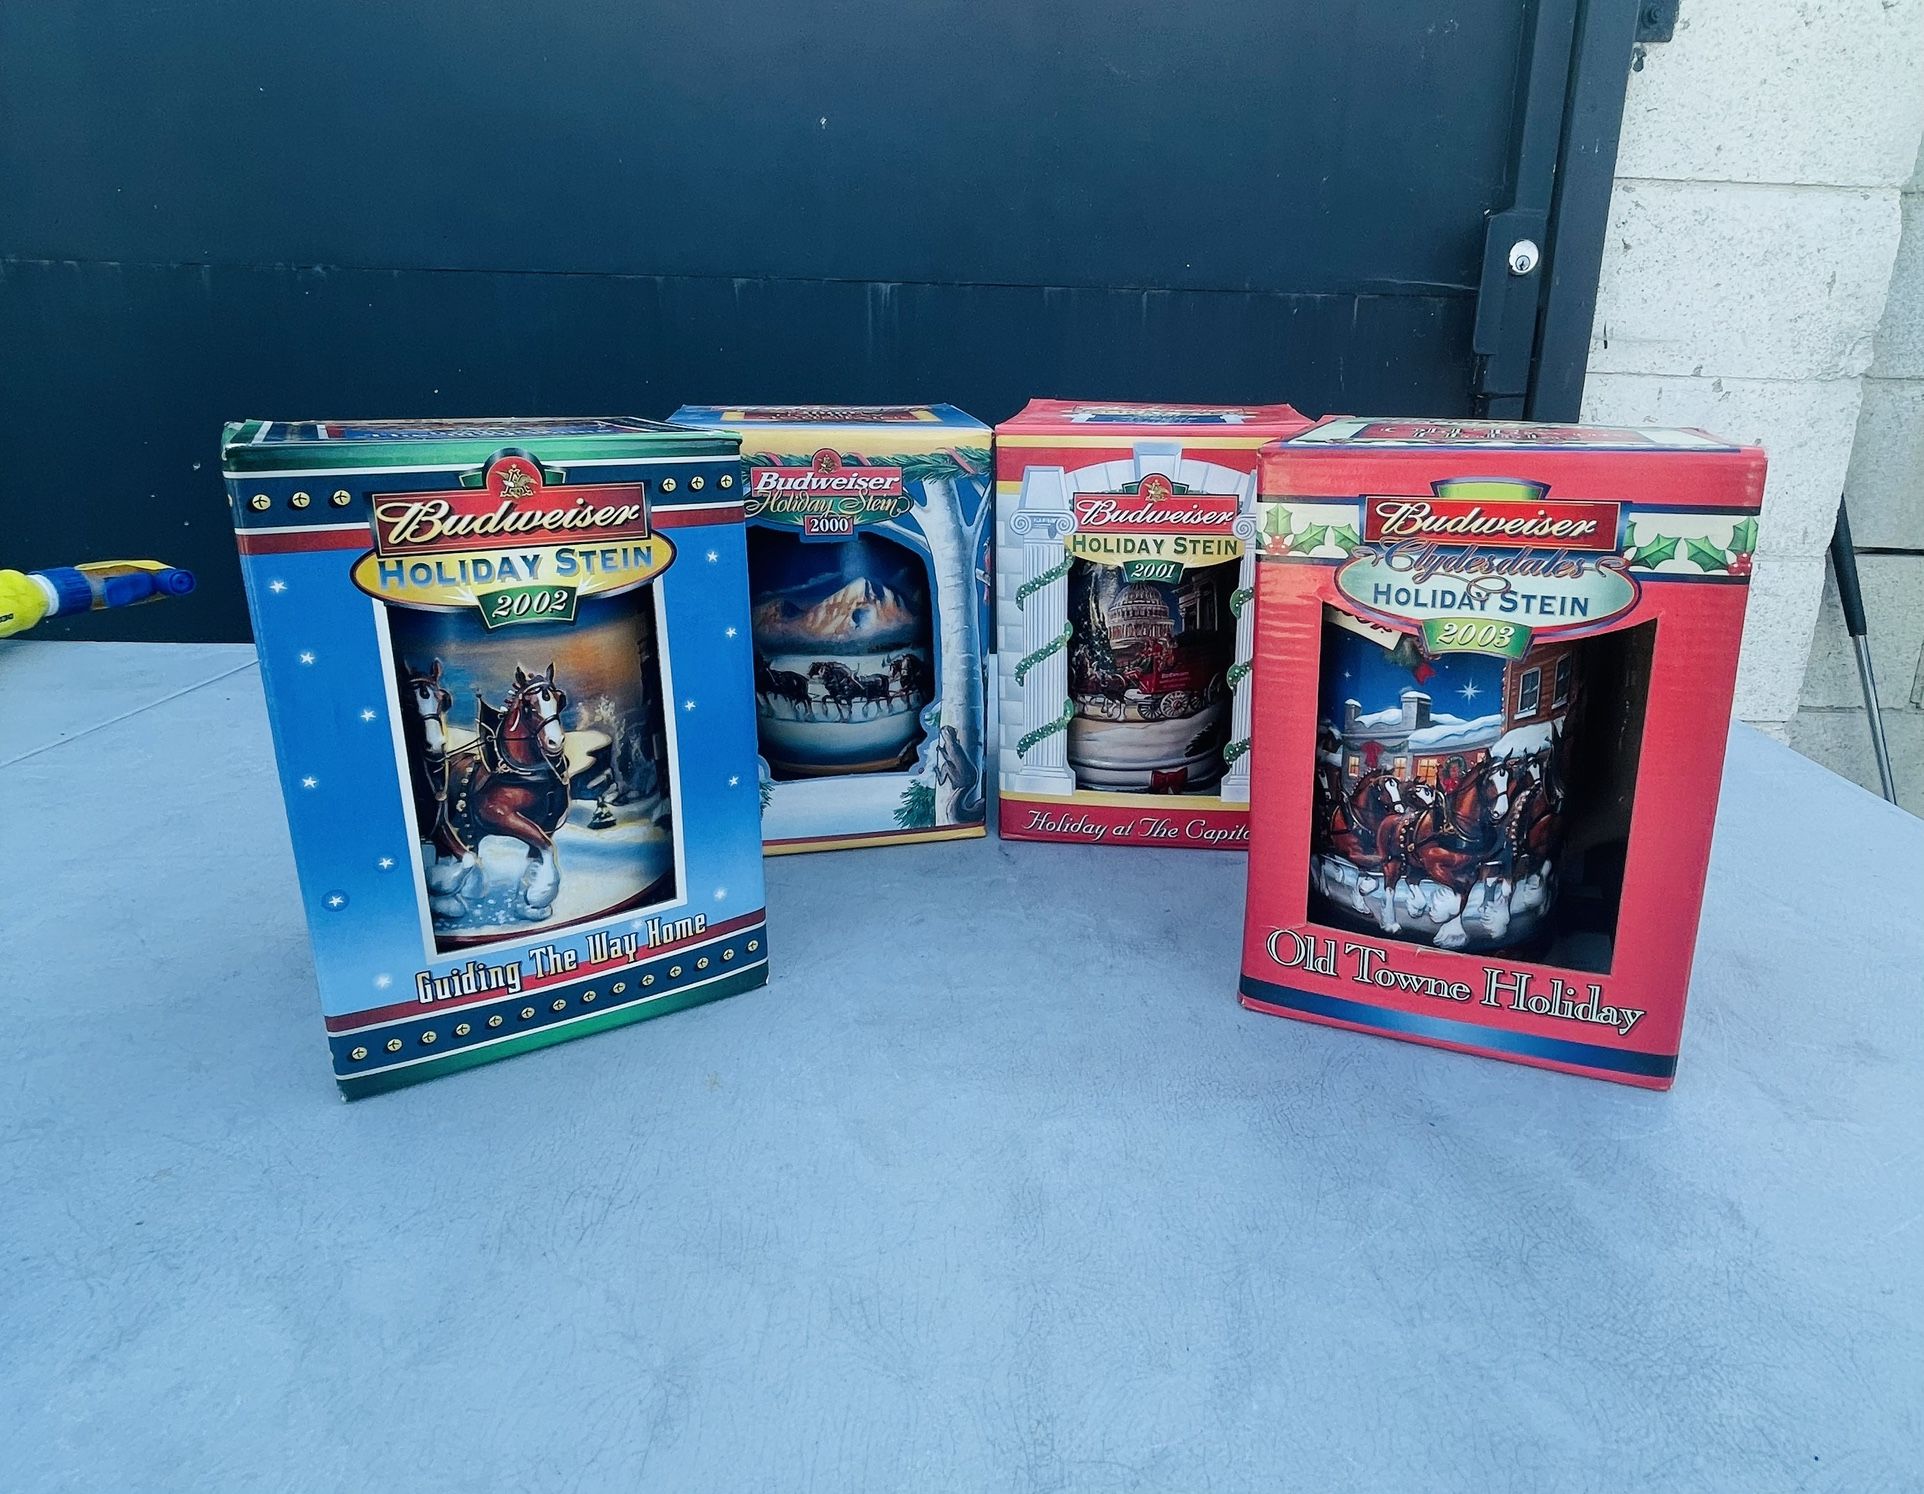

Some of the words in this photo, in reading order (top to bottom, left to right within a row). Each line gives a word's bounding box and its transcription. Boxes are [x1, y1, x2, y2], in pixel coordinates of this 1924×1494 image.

[754, 472, 900, 491] Budweiser
[745, 490, 834, 519] Holiday
[838, 489, 914, 518] Stein
[1076, 499, 1235, 526] Budweiser
[1375, 501, 1598, 537] Budweiser
[376, 498, 640, 545] Budweiser
[810, 518, 849, 532] 2000
[1072, 535, 1165, 555] HOLIDAY
[1173, 536, 1238, 555] STEIN
[377, 554, 542, 590] HOLIDAY
[555, 546, 653, 578] STEIN
[1131, 562, 1175, 579] 2001
[1376, 536, 1590, 586] Clydesdales
[492, 589, 568, 617] 2002
[1373, 583, 1490, 613] HOLIDAY
[1498, 591, 1589, 617] STEIN
[1436, 622, 1515, 648] 2003
[1023, 810, 1109, 841] Holiday
[1112, 820, 1134, 836] at
[1138, 817, 1179, 838] The
[415, 961, 521, 1003] Guiding
[529, 945, 577, 979] The
[586, 932, 638, 963] Way
[646, 913, 707, 949] Home
[1266, 928, 1338, 977] Old
[1345, 942, 1472, 1002] Towne
[1480, 966, 1649, 1036] Holiday
